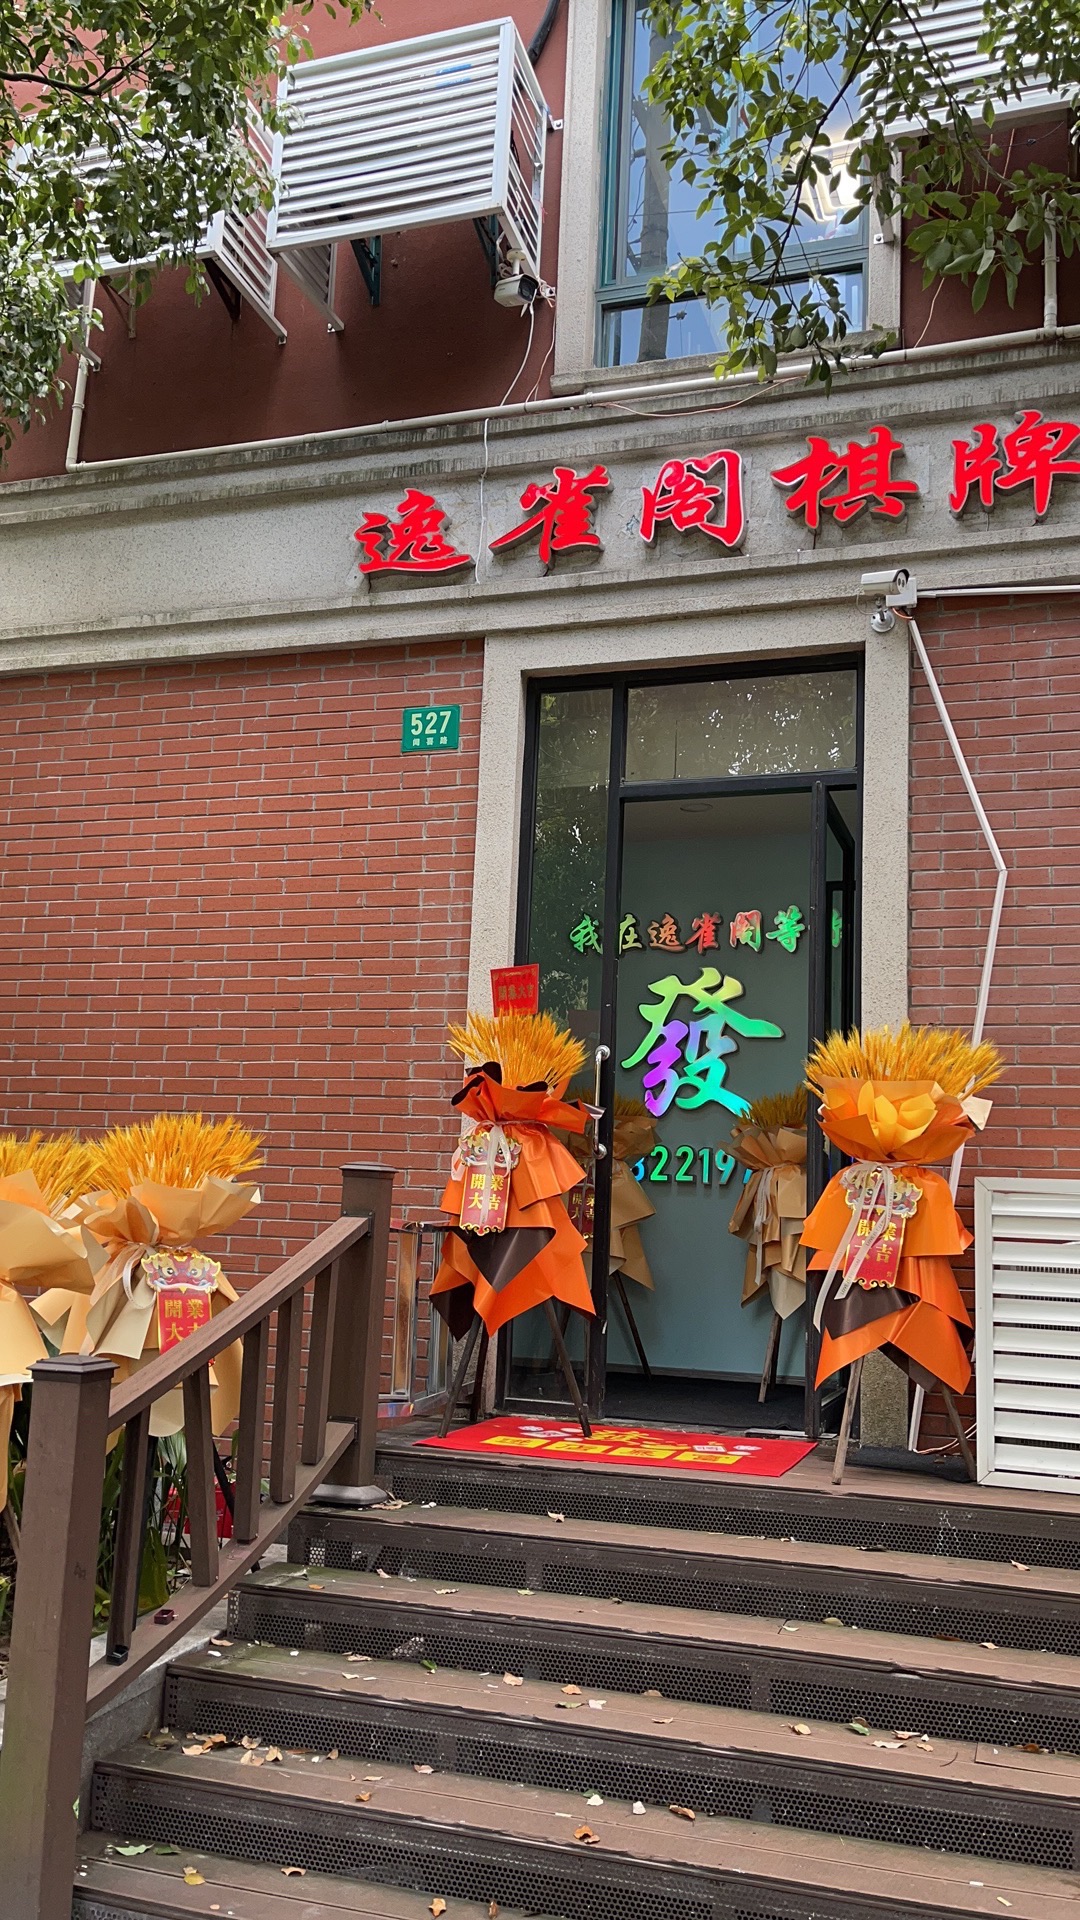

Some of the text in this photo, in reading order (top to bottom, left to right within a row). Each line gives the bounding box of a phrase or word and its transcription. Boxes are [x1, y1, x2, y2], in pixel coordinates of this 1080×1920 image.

[411, 710, 451, 735] 527
[621, 966, 785, 1118] 發
[164, 1298, 205, 1319] 開業
